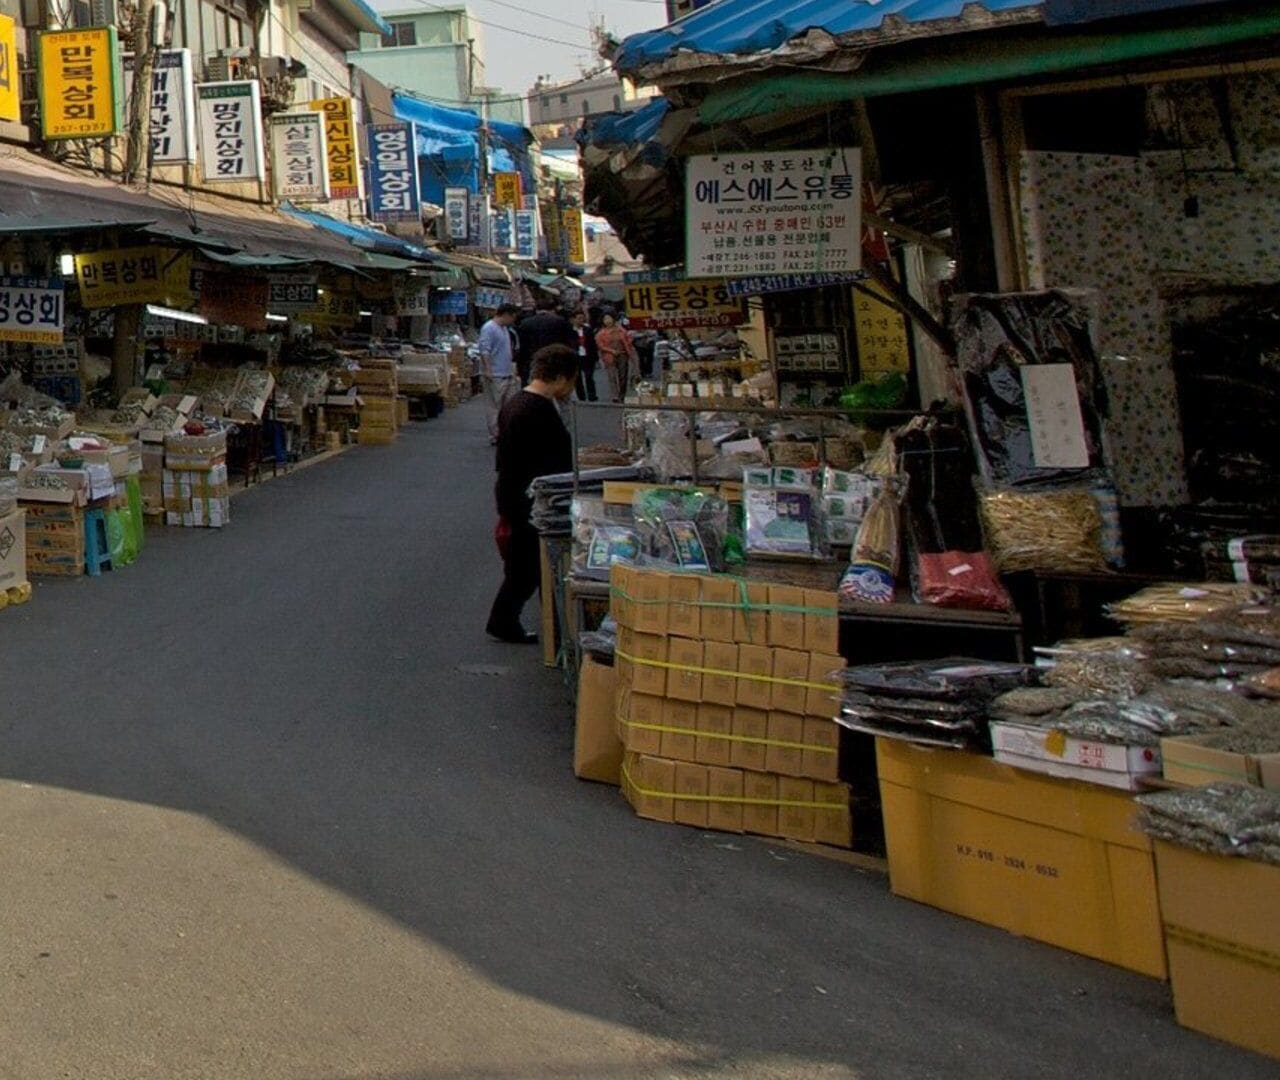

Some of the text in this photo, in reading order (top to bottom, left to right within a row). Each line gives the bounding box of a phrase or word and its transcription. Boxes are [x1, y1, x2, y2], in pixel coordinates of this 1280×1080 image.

[61, 45, 99, 121] 만복상회
[213, 101, 245, 176] 명진상회
[322, 98, 355, 185] 일신상회
[374, 129, 413, 212] 영일상회
[695, 174, 853, 204] 에스에스유통
[700, 220, 738, 234] 부산시
[628, 285, 738, 312] 대동상회
